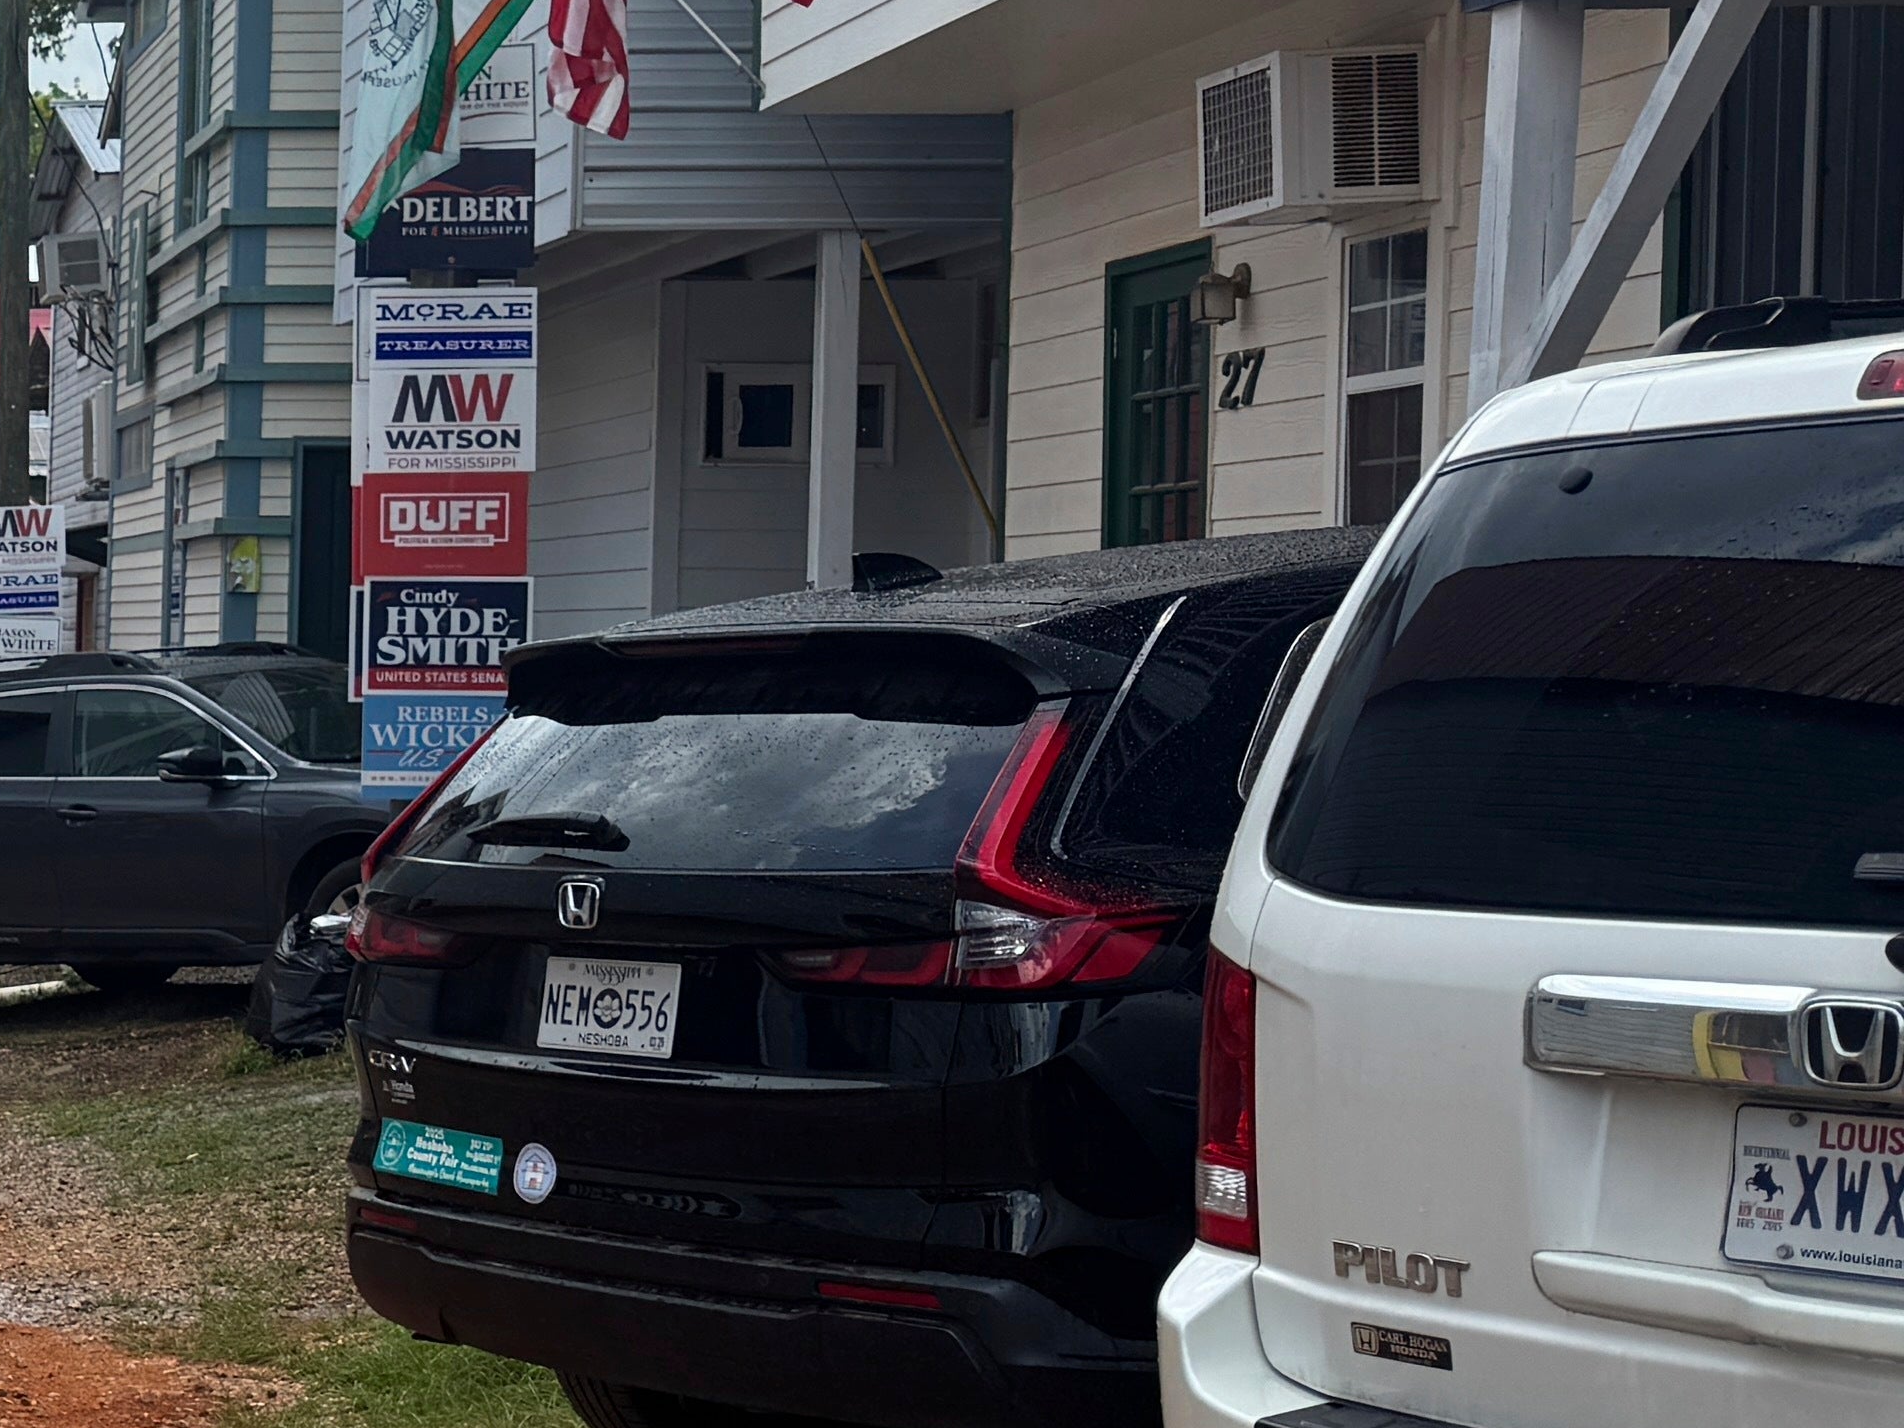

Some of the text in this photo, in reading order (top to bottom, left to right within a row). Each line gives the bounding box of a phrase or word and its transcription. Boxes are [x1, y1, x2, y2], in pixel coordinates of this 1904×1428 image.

[463, 80, 530, 101] HITE
[402, 196, 533, 223] DELBERT
[402, 225, 529, 236] FOR MISSISSIPPI
[378, 338, 531, 353] TREASURER
[1218, 347, 1266, 410] 27
[391, 373, 514, 423] MW
[385, 428, 521, 450] WATSON
[388, 456, 517, 470] FOR MISSISSIPPI
[389, 500, 500, 532] DUFF
[399, 588, 460, 607] Cindy
[386, 606, 520, 636] HYDE-
[1, 638, 56, 651] WHITE
[376, 636, 523, 666] SMITH
[376, 670, 506, 684] UNITED STATES SENA
[397, 706, 489, 723] REBELS
[398, 749, 444, 768] U.S.
[545, 983, 671, 1032] NEM 556
[578, 1032, 629, 1047] NESHOBA
[439, 1152, 459, 1169] Fair
[1331, 1238, 1471, 1298] PILOT
[1379, 1329, 1448, 1353] CARL HOGAN
[1391, 1344, 1438, 1361] HONDA
